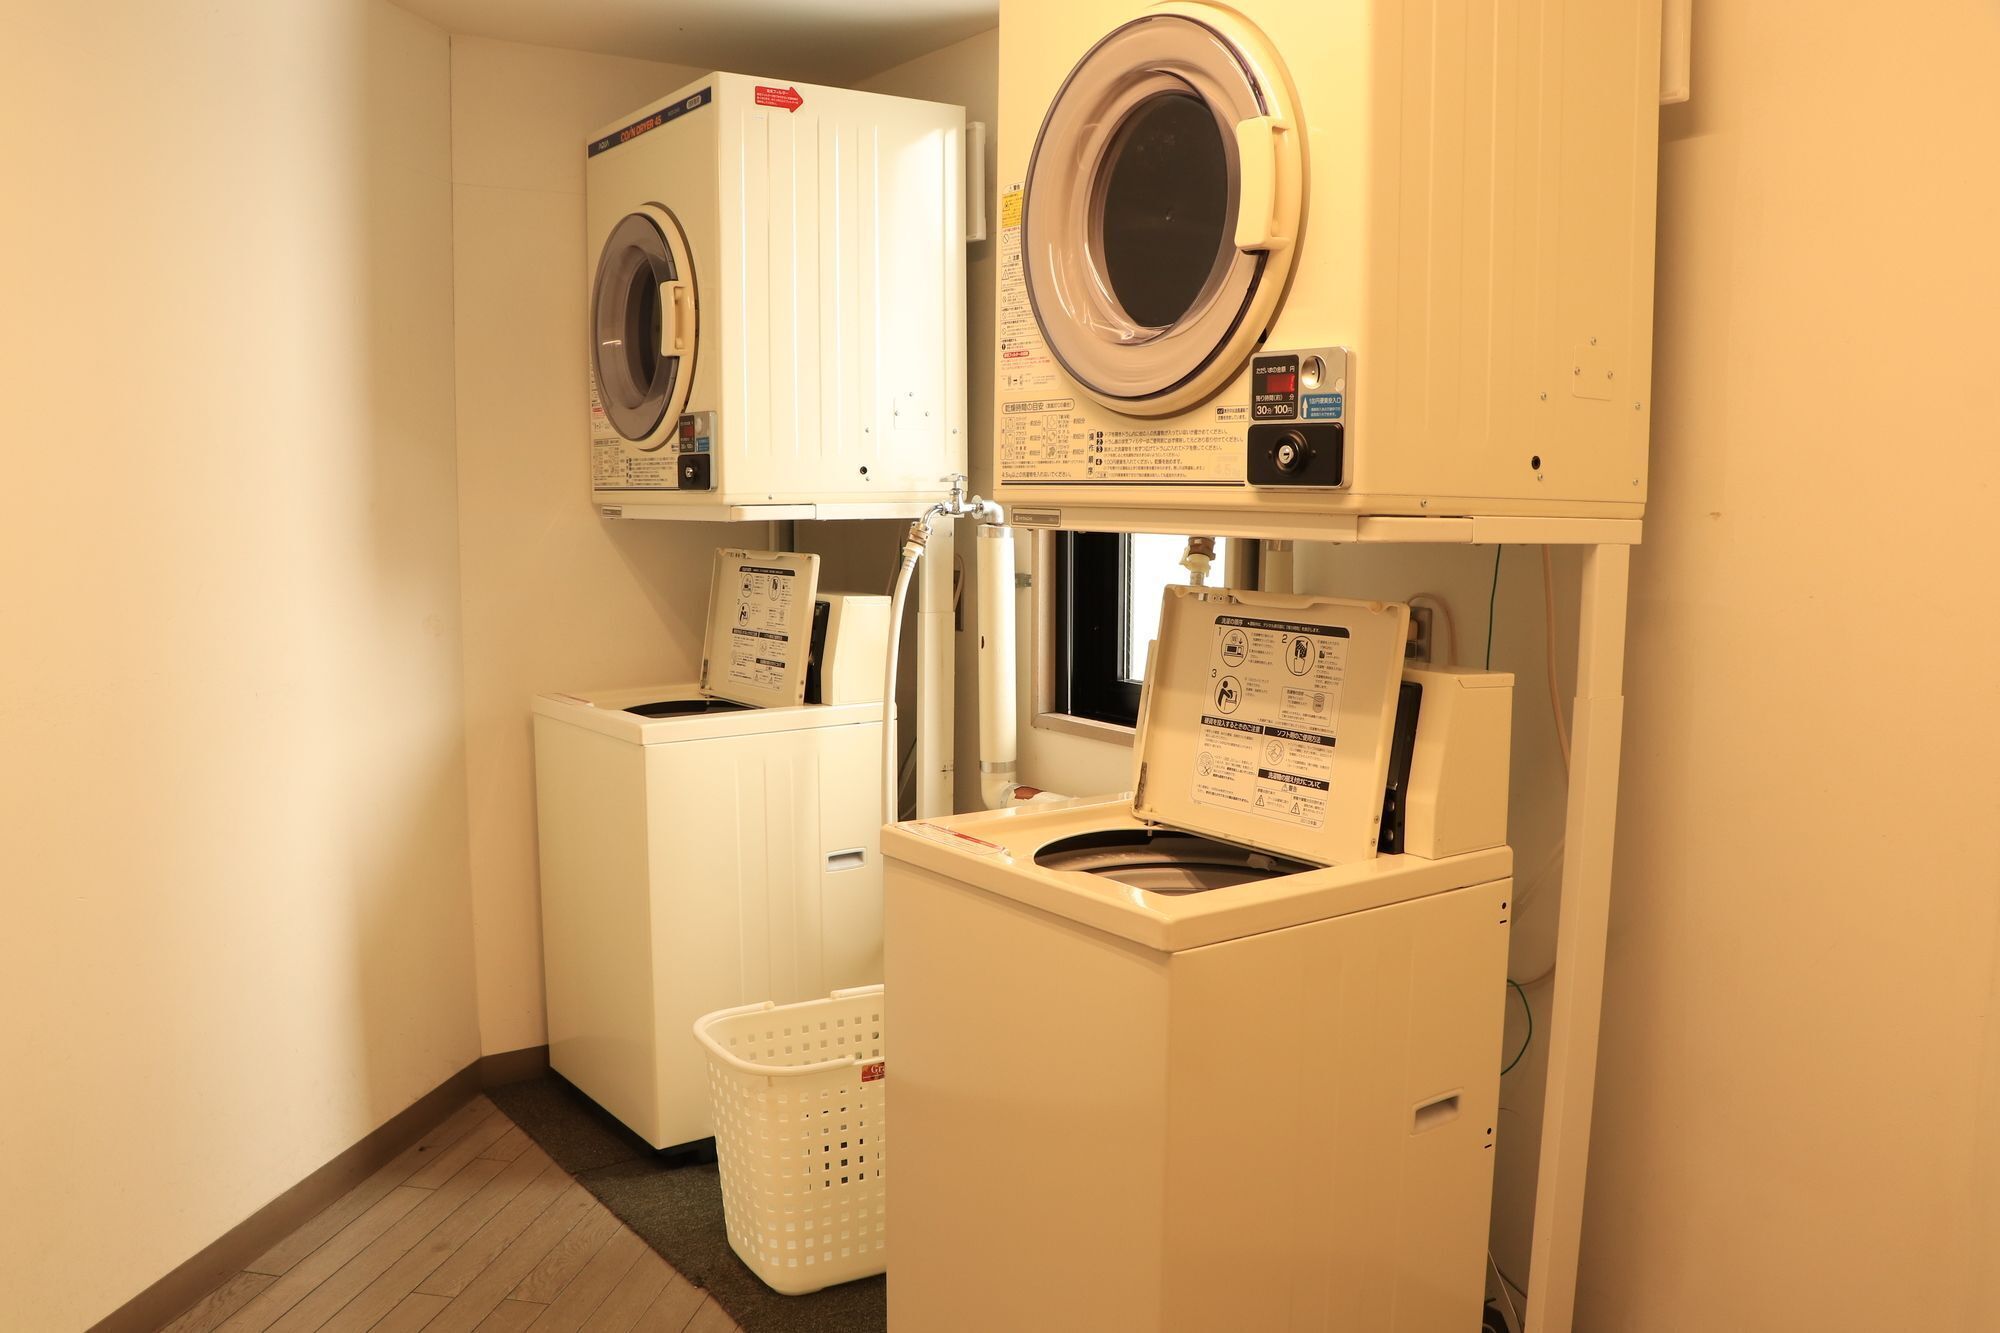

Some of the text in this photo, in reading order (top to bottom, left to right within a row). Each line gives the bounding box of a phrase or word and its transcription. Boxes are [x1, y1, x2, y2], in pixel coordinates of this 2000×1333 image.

[635, 119, 655, 137] DRYER
[1004, 402, 1044, 412] 乾燥時間の目安
[1281, 633, 1288, 644] 2
[1211, 668, 1217, 678] 3
